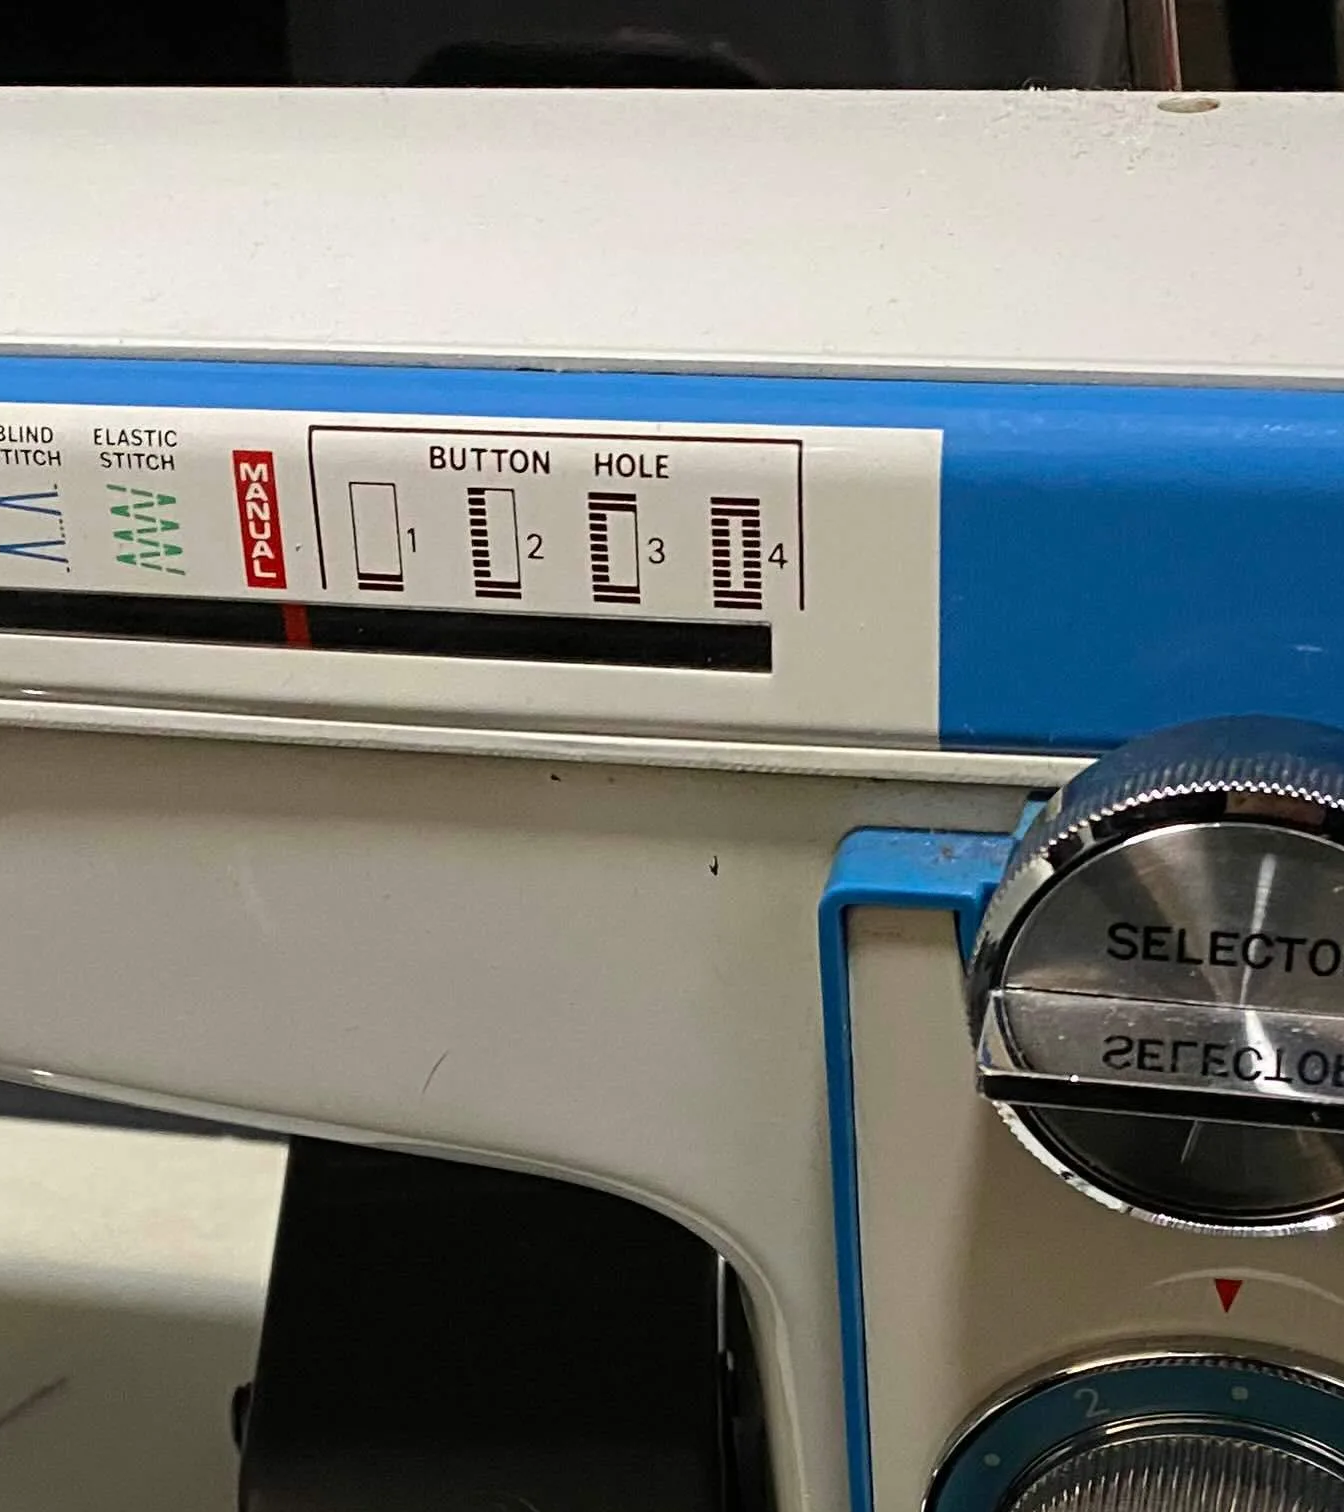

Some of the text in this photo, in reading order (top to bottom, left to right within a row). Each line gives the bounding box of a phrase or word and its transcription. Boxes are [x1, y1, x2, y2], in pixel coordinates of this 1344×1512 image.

[93, 428, 178, 448] ELASTIC
[99, 452, 176, 472] STITCH
[429, 446, 670, 480] BUTTON HOLE
[239, 462, 278, 579] MANUAL
[406, 527, 788, 570] 1 2 3 4
[1074, 1387, 1111, 1418] 2
